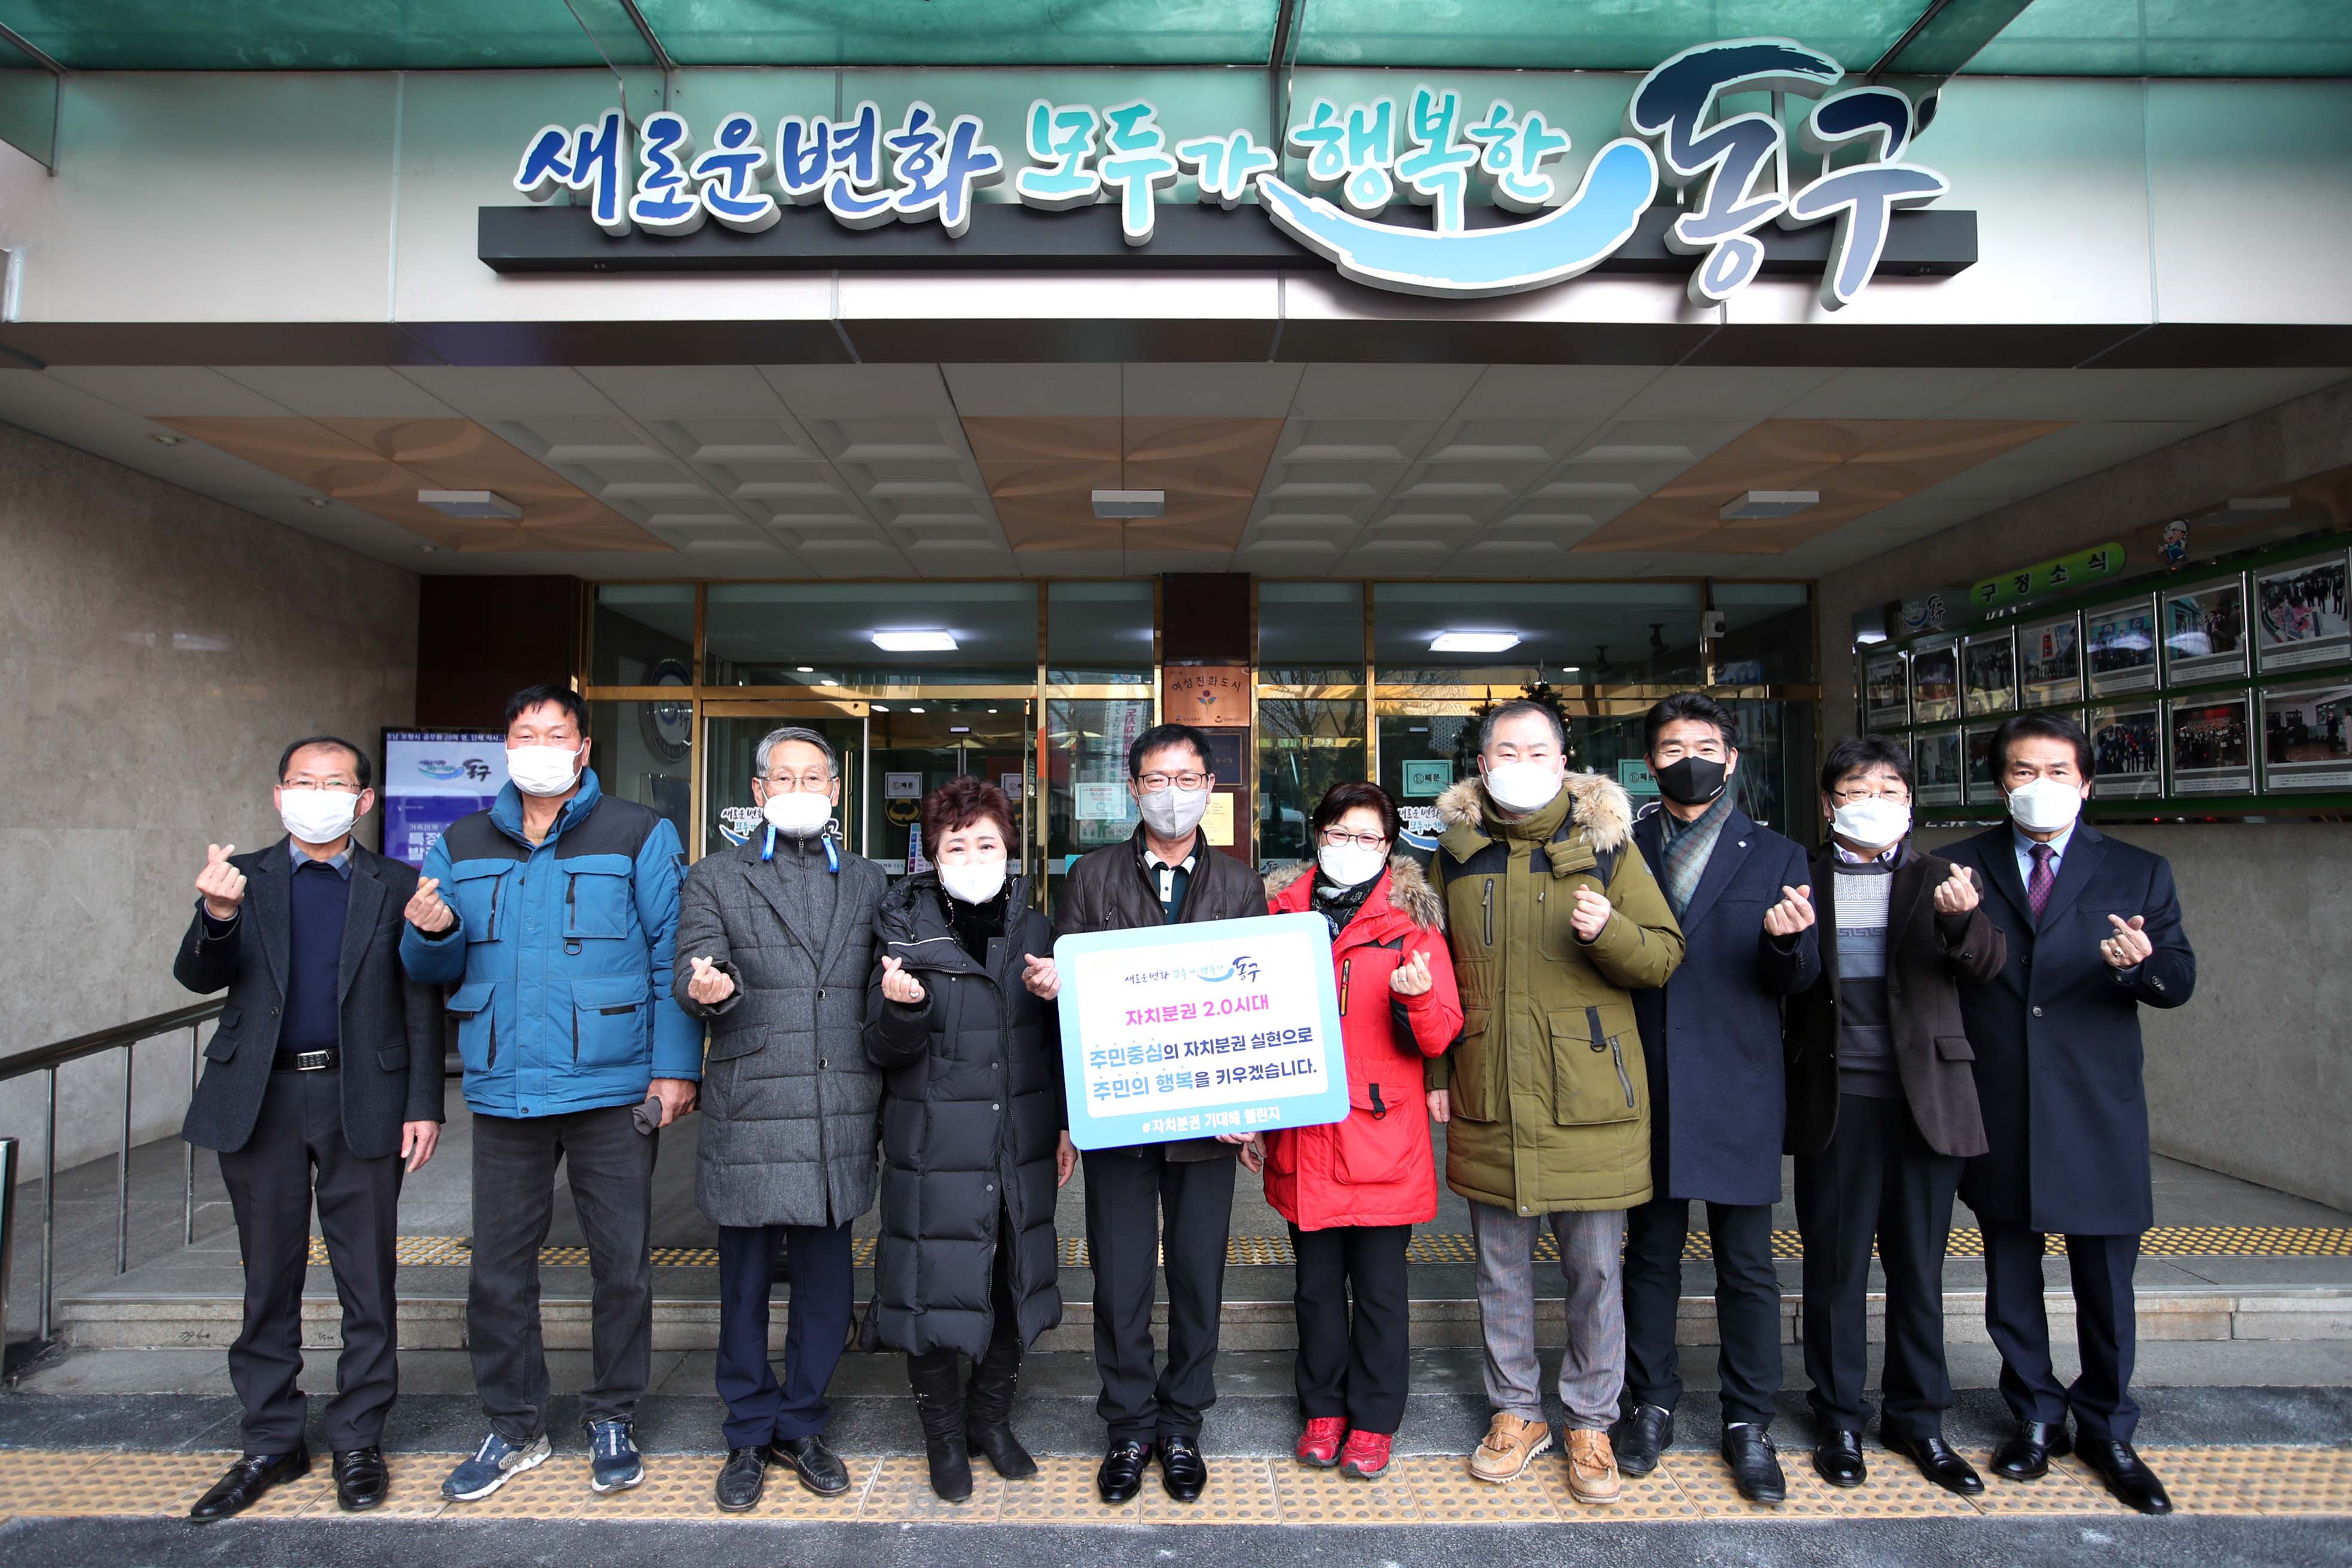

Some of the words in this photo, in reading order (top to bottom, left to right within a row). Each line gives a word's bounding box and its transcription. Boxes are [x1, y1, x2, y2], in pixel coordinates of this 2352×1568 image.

[1016, 102, 1269, 236] 모두가
[1295, 87, 1569, 232] 행복한
[1632, 41, 1949, 302] 동구
[1232, 955, 1261, 983] 동구
[1126, 1002, 1197, 1026] 자치분권
[1202, 994, 1269, 1017] 2.0시대
[1090, 1043, 1179, 1069] 주민중심의
[1184, 1035, 1246, 1057] 자치분권
[1251, 1027, 1313, 1050] 실현으로
[1093, 1077, 1149, 1101] 주민의
[1156, 1071, 1210, 1093] 행복을
[1215, 1058, 1317, 1085] 키우겠습니다.
[1204, 1109, 1241, 1128] 기대해
